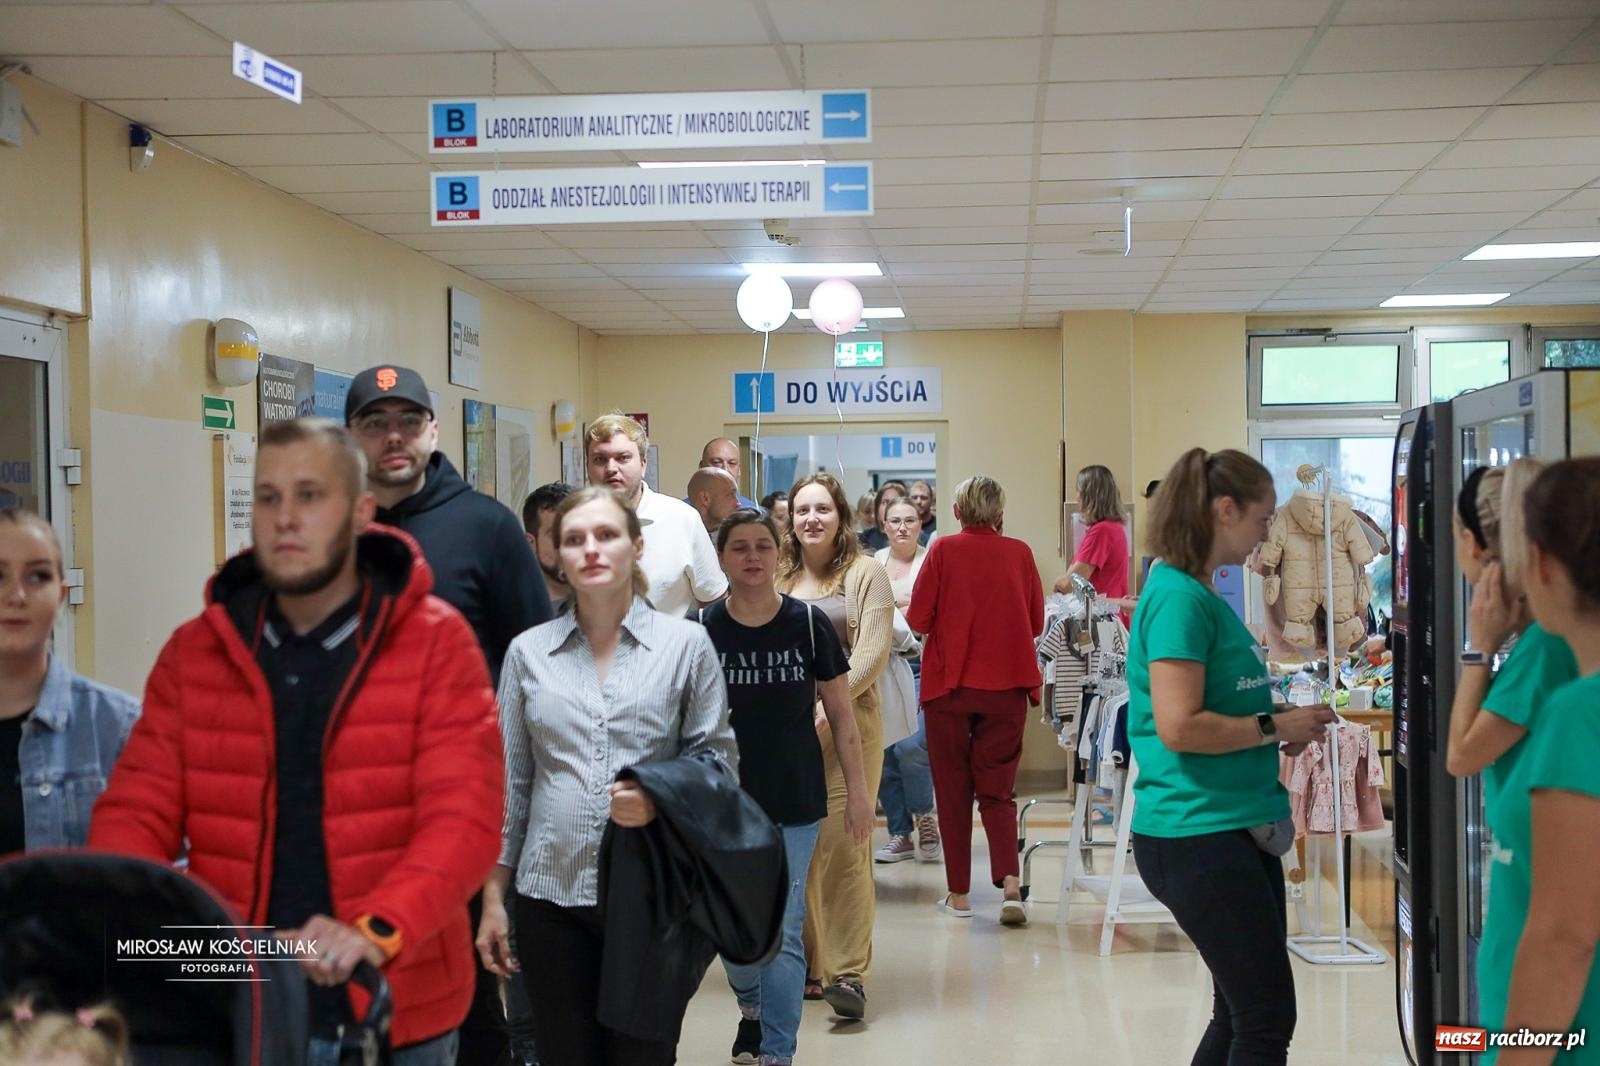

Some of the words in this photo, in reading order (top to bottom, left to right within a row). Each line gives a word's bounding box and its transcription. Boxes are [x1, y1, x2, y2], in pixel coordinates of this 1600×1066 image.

[446, 108, 466, 133] B
[485, 116, 584, 139] LABORATORIUM
[588, 113, 673, 137] ANALITYCZNE
[676, 113, 682, 136] /
[685, 110, 811, 134] MIKROBIOLOGICZNE
[443, 138, 467, 147] BLOK
[448, 181, 468, 206] B
[492, 187, 547, 209] ODDZIAŁ
[551, 184, 656, 208] ANESTEZJOLOGII
[659, 184, 664, 205] I
[667, 182, 757, 205] INTENSYWNEJ
[762, 180, 811, 203] TERAPII
[446, 211, 470, 220] BLOK
[263, 380, 296, 400] CHOROBY
[786, 381, 818, 404] DO
[826, 374, 928, 403] WYJŚCIA
[907, 441, 925, 454] DO
[718, 648, 804, 668] LAUDIA
